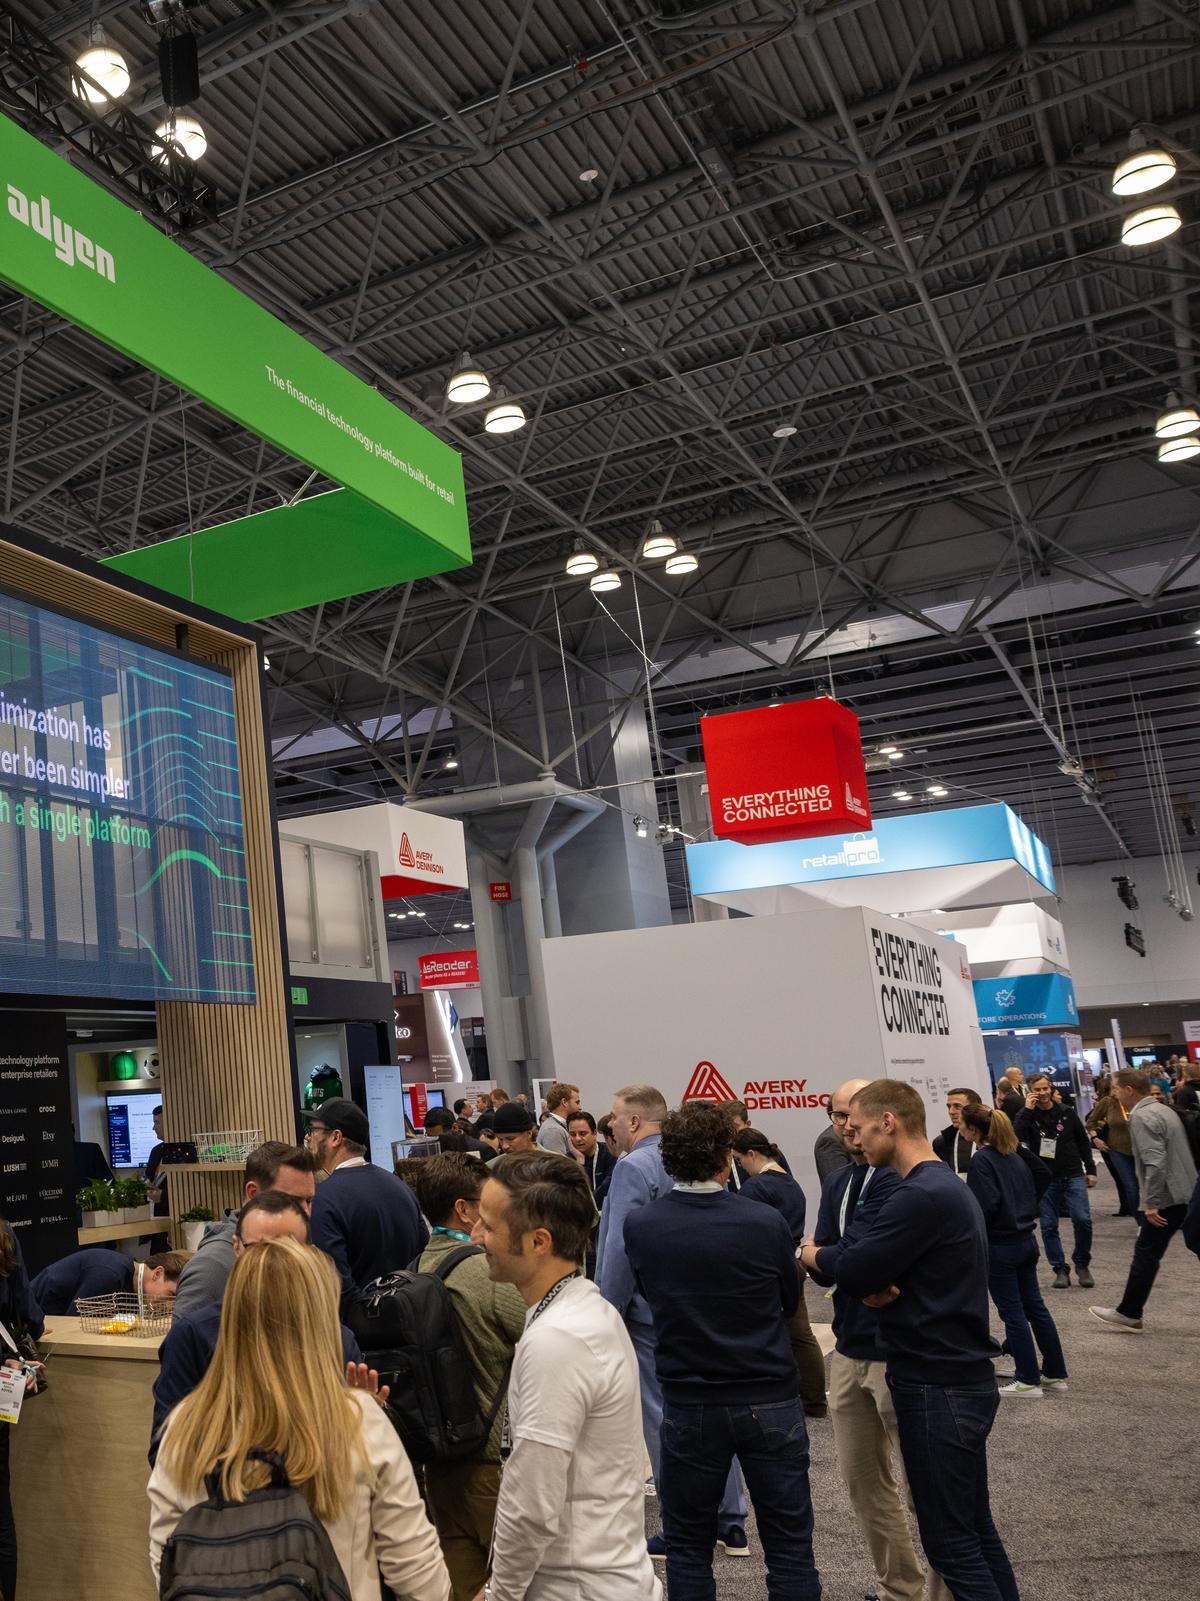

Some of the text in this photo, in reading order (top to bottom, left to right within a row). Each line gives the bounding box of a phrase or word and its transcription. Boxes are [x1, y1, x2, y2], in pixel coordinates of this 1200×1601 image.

[7, 183, 116, 284] adyen
[265, 365, 455, 506] The financial technology platform built for retail
[82, 715, 111, 751] has
[24, 746, 67, 786] been
[71, 761, 130, 803] simpler
[722, 784, 830, 810] EVERYTHING
[723, 798, 832, 823] CONNECTED
[15, 801, 25, 826] a
[29, 799, 81, 842] single
[86, 809, 150, 849] platform
[416, 850, 433, 862] AVERY
[416, 861, 444, 874] DENNISON
[871, 928, 942, 988] EVERYTHING
[423, 960, 472, 973] AsReader
[882, 984, 950, 1035] CONNECTED
[998, 1012, 1047, 1022] OPERATIONS
[0, 1056, 33, 1067] technology
[34, 1055, 60, 1066] platform
[1, 1069, 33, 1081] enterprise
[34, 1069, 58, 1078] retailers
[743, 1079, 807, 1094] AVERY
[39, 1105, 56, 1113] crocs
[43, 1131, 55, 1142] Etsy
[3, 1164, 20, 1172] LUSH
[42, 1159, 59, 1169] LVMH
[6, 1194, 28, 1202] MEJURI
